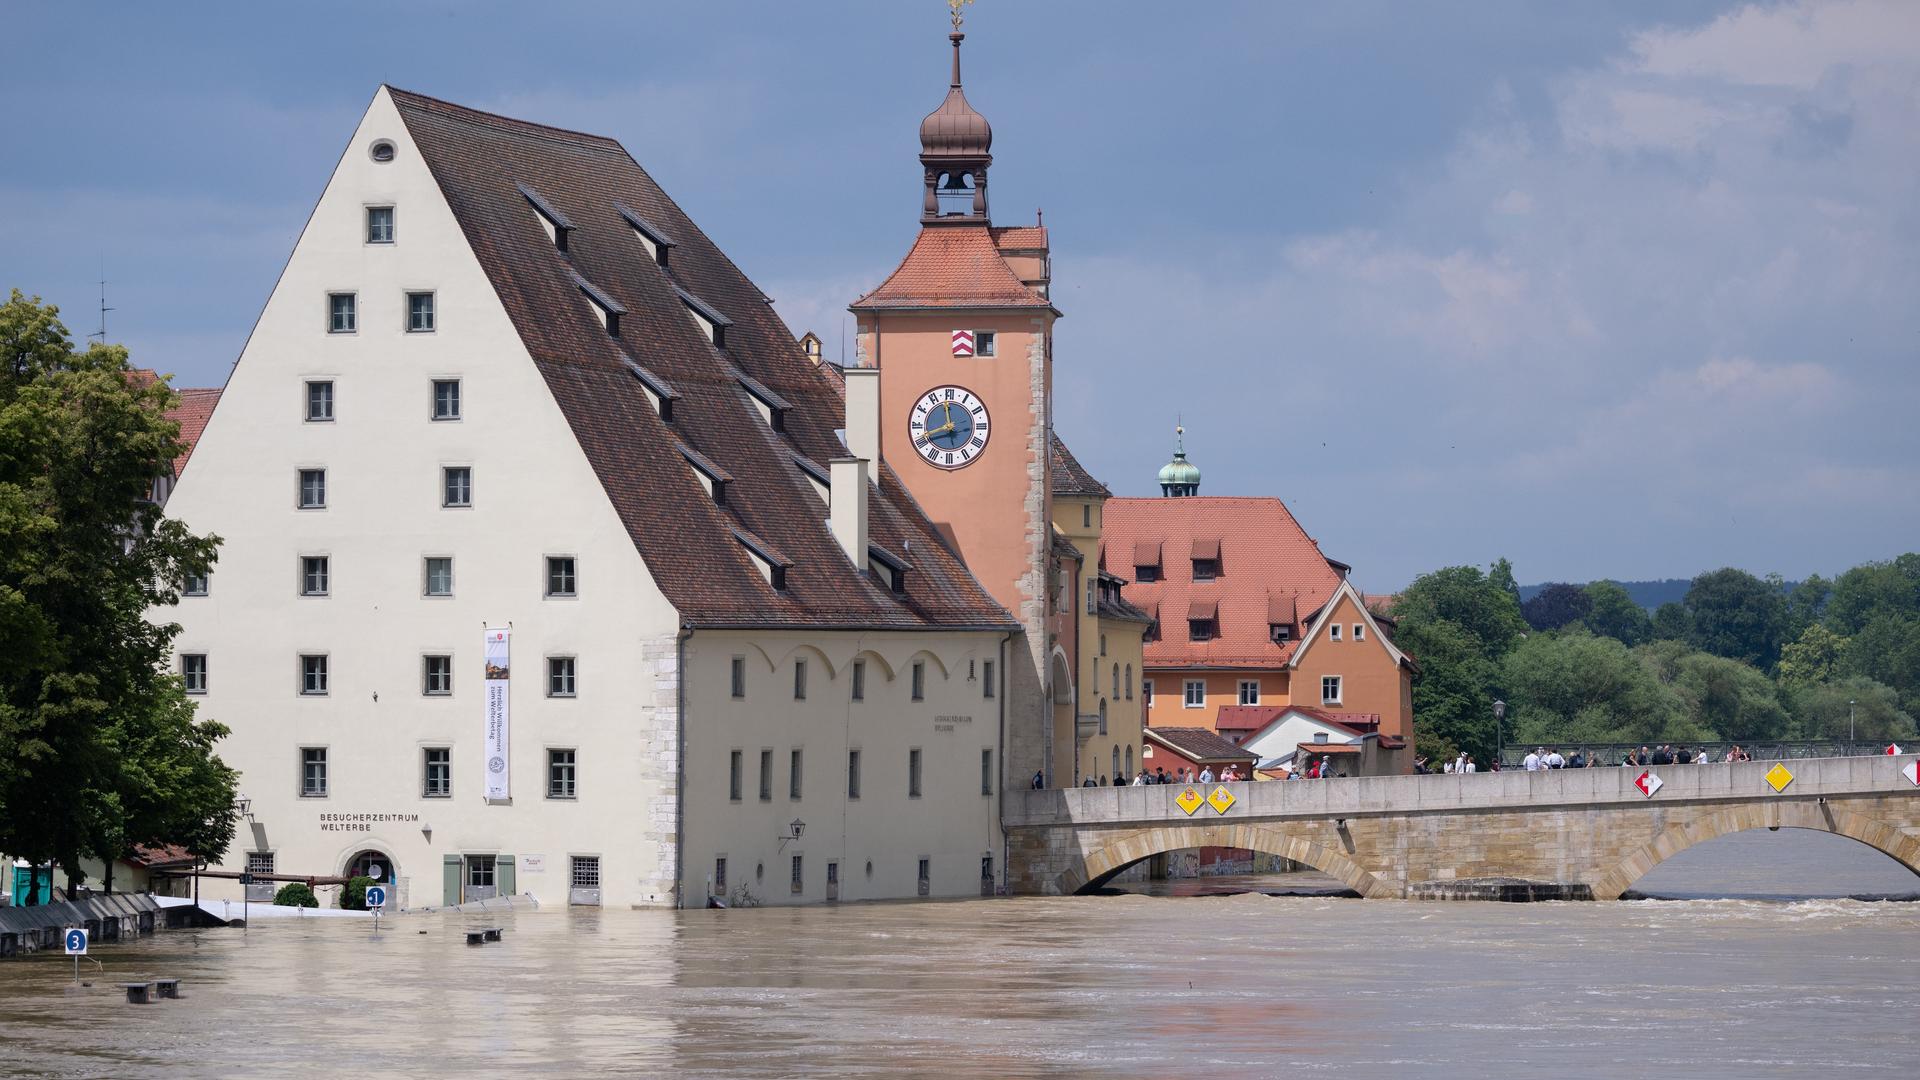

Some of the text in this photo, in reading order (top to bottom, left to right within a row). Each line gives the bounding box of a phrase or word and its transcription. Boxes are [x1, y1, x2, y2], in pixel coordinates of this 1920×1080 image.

[320, 814, 418, 822] BESUCHERZENTRUM
[320, 824, 370, 832] WELTERBE
[373, 892, 378, 902] 1
[72, 935, 79, 950] 3
